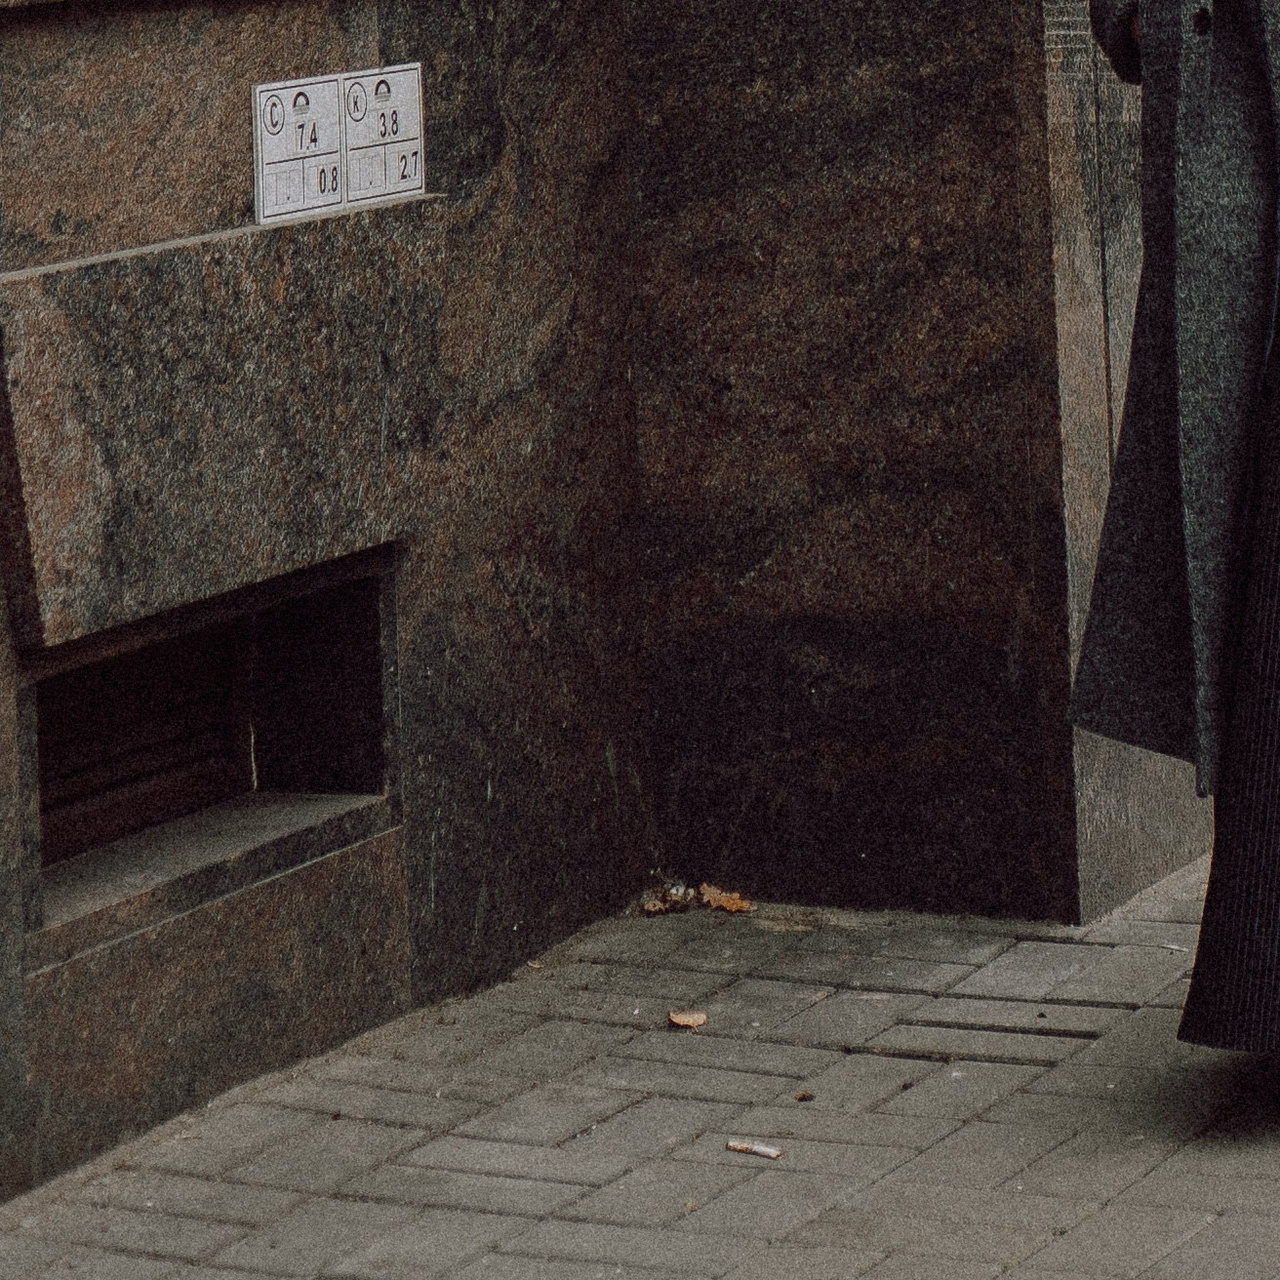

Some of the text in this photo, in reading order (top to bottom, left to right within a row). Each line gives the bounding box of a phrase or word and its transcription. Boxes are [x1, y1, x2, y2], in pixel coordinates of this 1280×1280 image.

[297, 122, 318, 150] 7.4
[379, 110, 399, 138] 3.8
[400, 151, 418, 180] 2.7
[319, 166, 338, 195] 0.8
